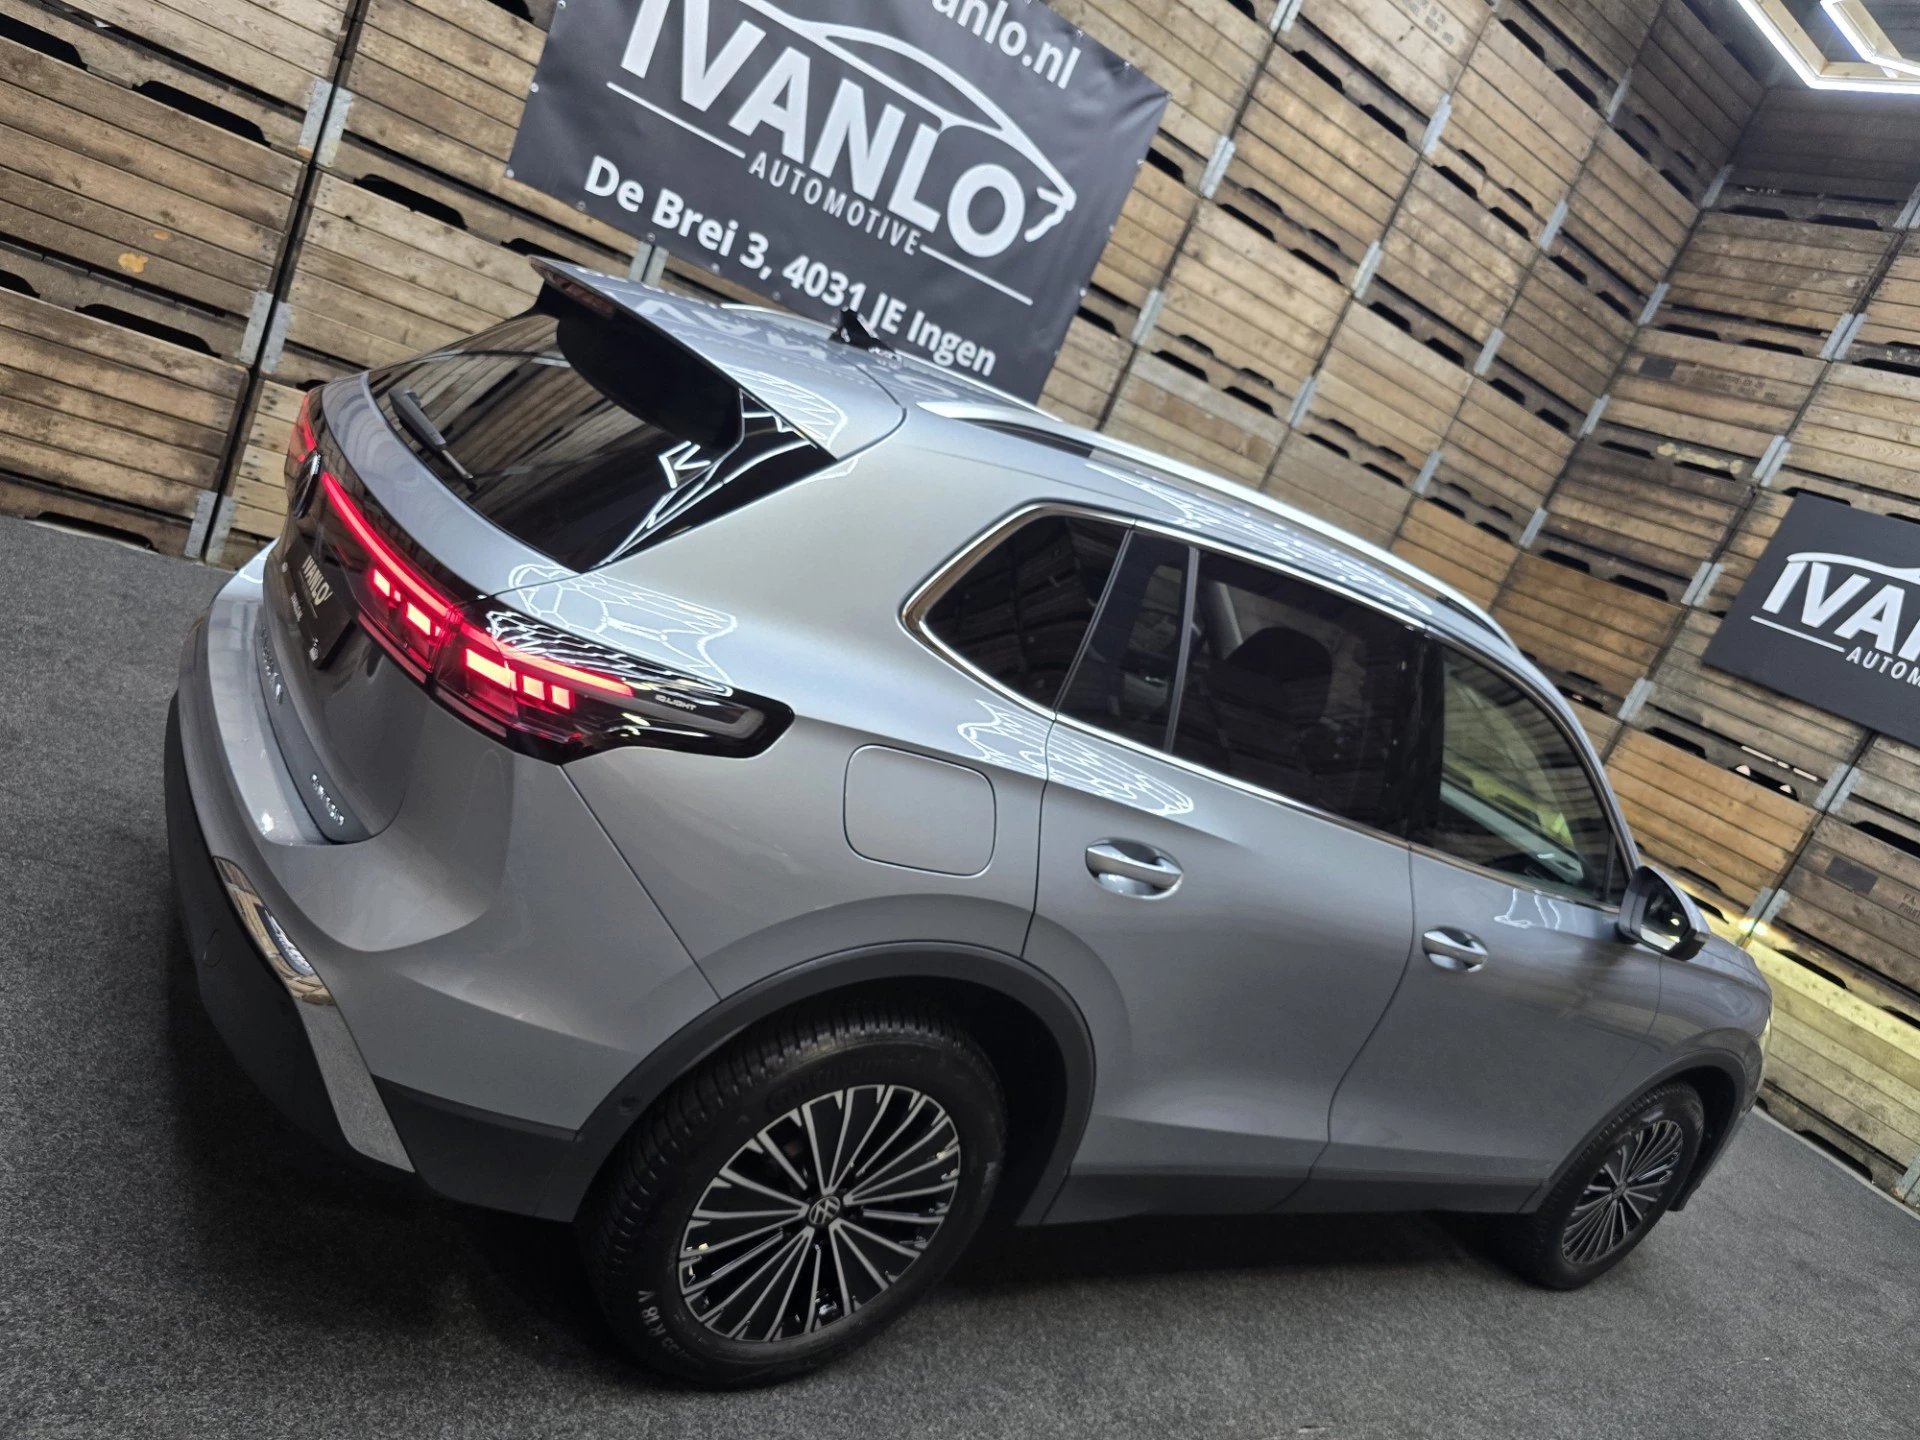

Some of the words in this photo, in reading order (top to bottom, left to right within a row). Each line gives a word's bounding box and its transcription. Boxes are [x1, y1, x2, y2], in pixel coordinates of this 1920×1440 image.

[620, 0, 1026, 258] IVANLO
[748, 151, 922, 256] AUTOMOTIVE
[584, 154, 645, 213] De
[651, 187, 740, 257] Brei
[738, 231, 773, 281] 3,
[782, 255, 867, 311] 4031
[867, 292, 908, 334] JE
[906, 310, 997, 377] Ingen
